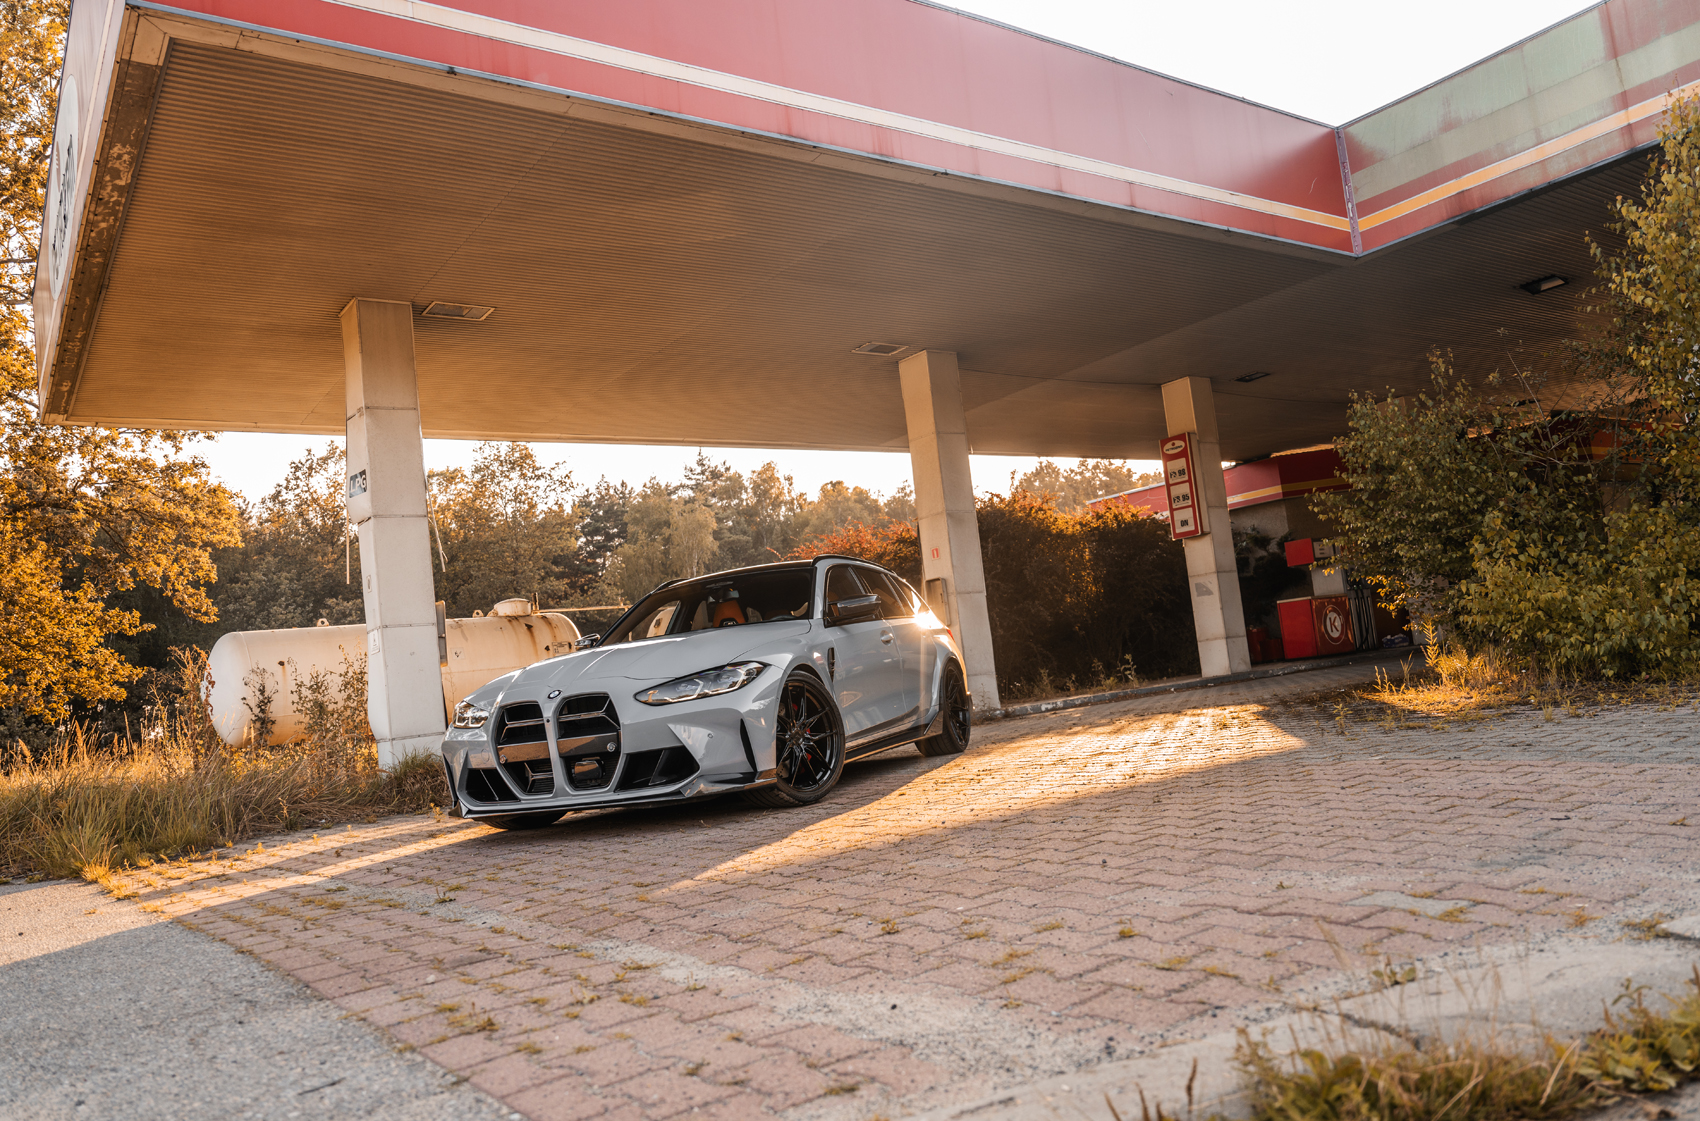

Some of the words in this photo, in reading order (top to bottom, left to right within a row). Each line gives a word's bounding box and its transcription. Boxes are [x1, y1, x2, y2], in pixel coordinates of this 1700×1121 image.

[1178, 468, 1186, 477] 98
[350, 474, 366, 493] LPG
[1182, 493, 1190, 502] 95
[1328, 616, 1339, 633] K
